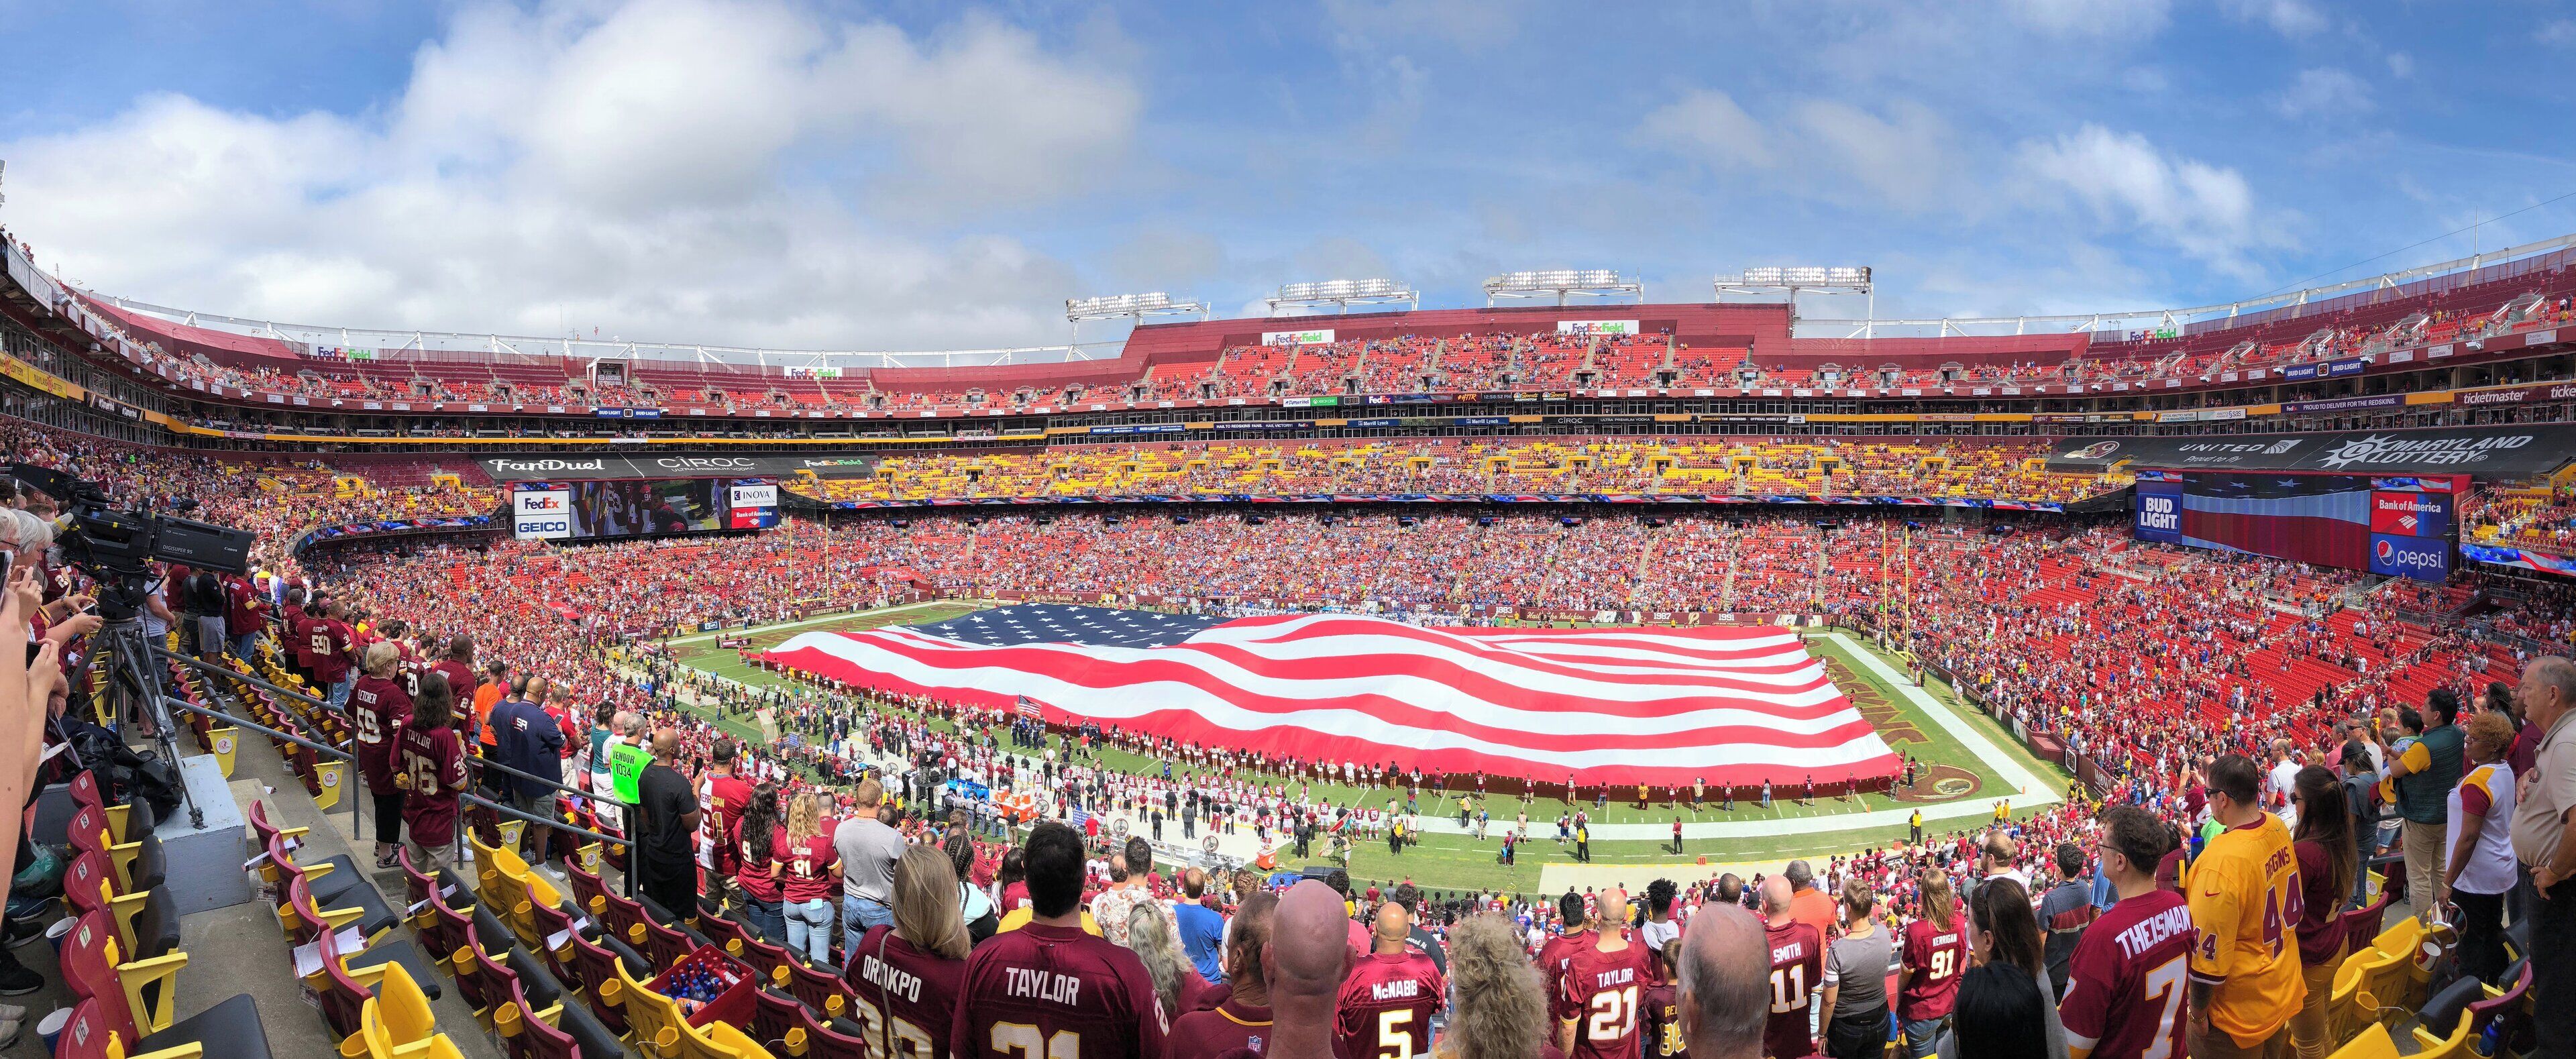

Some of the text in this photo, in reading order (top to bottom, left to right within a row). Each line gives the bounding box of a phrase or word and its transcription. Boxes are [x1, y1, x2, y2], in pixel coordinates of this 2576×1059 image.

[1275, 330, 1322, 341] FedExField
[1572, 323, 1623, 333] FedExField
[2130, 328, 2176, 341] FedExField
[318, 346, 370, 359] FedExField
[792, 368, 836, 377] FedExField
[1368, 396, 1391, 404] FedEx
[2463, 391, 2525, 404] ticketmaster
[2388, 435, 2533, 451] MARYLAND
[804, 459, 863, 467] FedExField
[2367, 449, 2488, 464] LOTTERY
[488, 459, 605, 471] FanDuel
[743, 490, 770, 499] INOVA
[525, 497, 559, 510] FedEx
[2145, 498, 2173, 514] BUD
[2379, 500, 2441, 513] Bank of America
[518, 521, 567, 533] GEICO
[2140, 512, 2178, 530] LIGHT
[162, 545, 186, 554] DIGISUPER
[2397, 550, 2442, 570] pepsi
[407, 672, 419, 697] 21
[357, 705, 382, 744] 59
[511, 716, 527, 730] USA
[407, 728, 431, 749] TAYLOR
[613, 750, 635, 765] VENDOR
[615, 761, 633, 778] 1034
[794, 859, 813, 880] 91
[2265, 845, 2292, 883] RIGGINS
[2262, 871, 2304, 960] 44
[1932, 933, 1958, 947] KERRIGAN
[1773, 942, 1801, 964] SMITH
[1929, 948, 1955, 981] 91
[863, 954, 922, 1003] ORAKPO
[1597, 967, 1634, 988] TAYLOR
[1006, 966, 1080, 1006] TAYLOR
[1373, 979, 1418, 1001] McNABB
[1770, 964, 1807, 1013] 11
[1589, 985, 1638, 1041] 21
[2142, 953, 2188, 1059] 7
[1379, 1009, 1413, 1059] 5
